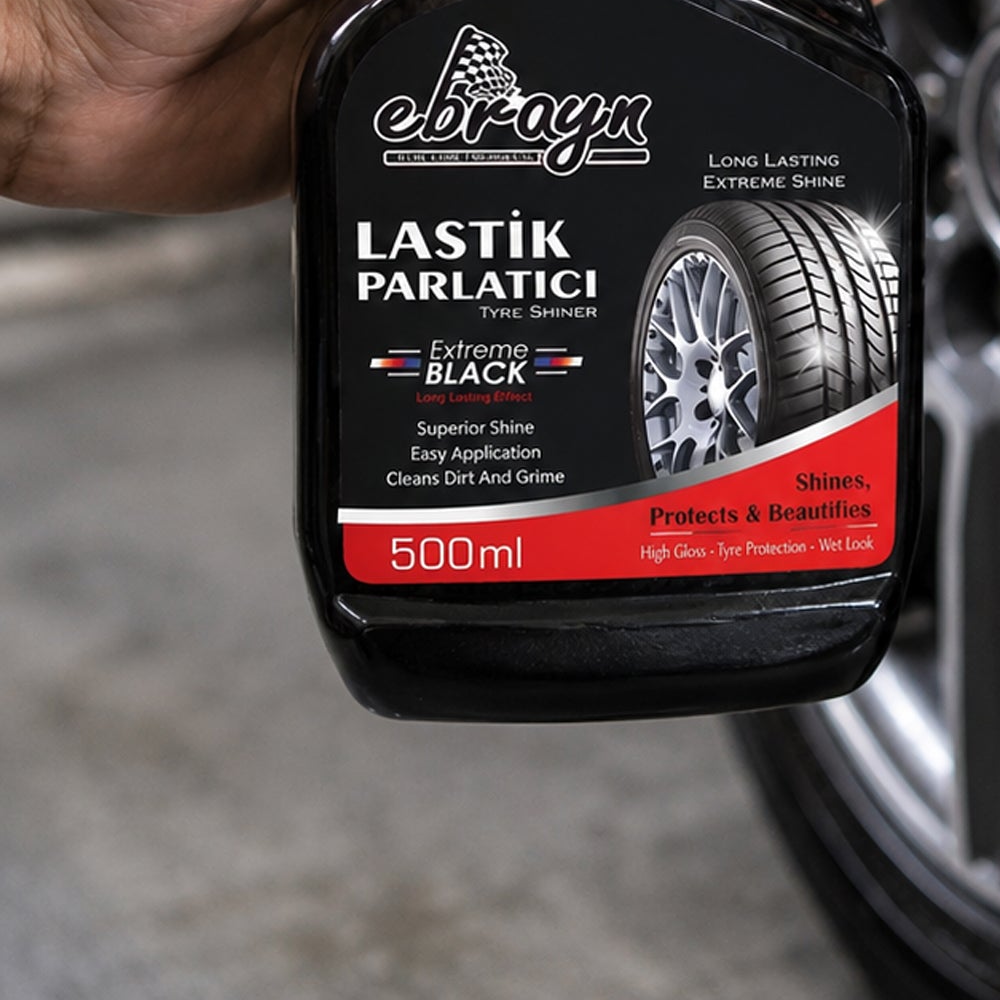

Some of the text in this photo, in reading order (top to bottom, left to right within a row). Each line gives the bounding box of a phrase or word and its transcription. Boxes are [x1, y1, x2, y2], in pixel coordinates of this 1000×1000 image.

[373, 23, 652, 176] ebrayn
[708, 153, 840, 168] LONG LASTING
[703, 174, 846, 190] EXTREME SHINE
[357, 209, 571, 260] LASTİK
[358, 269, 597, 301] PARLATICI
[529, 304, 598, 319] SHINER
[430, 339, 529, 361] Extreme
[424, 361, 528, 385] BLACK
[416, 392, 446, 404] Long
[417, 419, 535, 439] Superior Shine
[410, 444, 541, 464] Easy Application
[386, 468, 566, 487] Cleans Dirt And Grime
[795, 472, 871, 491] Shines,
[650, 500, 872, 526] Protects & Beautifies
[391, 536, 522, 571] 500ml
[640, 544, 670, 564] High
[673, 543, 706, 559] Gloss
[716, 541, 742, 561] Tyre
[745, 538, 807, 556] Protection
[818, 537, 843, 551] Wet
[845, 534, 875, 550] Look
